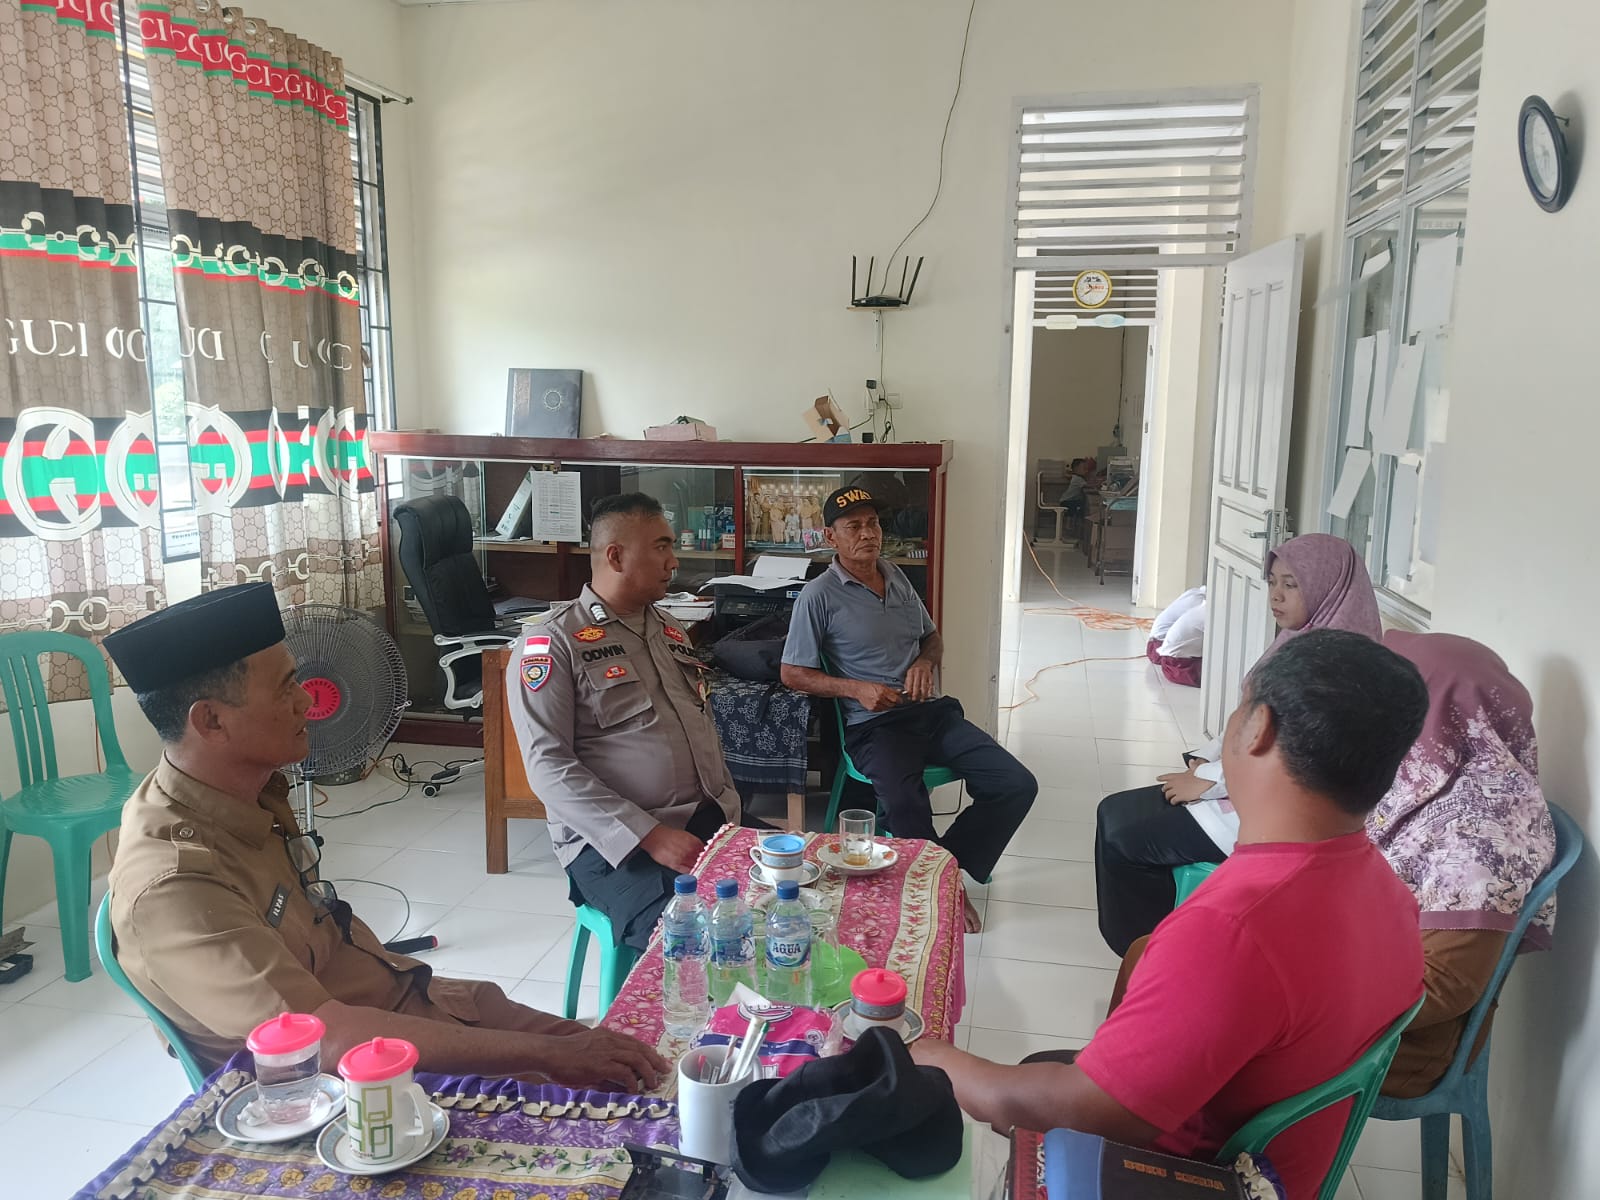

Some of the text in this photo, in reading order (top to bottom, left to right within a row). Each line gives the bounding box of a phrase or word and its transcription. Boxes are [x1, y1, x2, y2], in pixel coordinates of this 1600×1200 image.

[836, 489, 873, 508] SWA
[581, 644, 626, 662] ODWIN
[773, 942, 802, 956] AQUA
